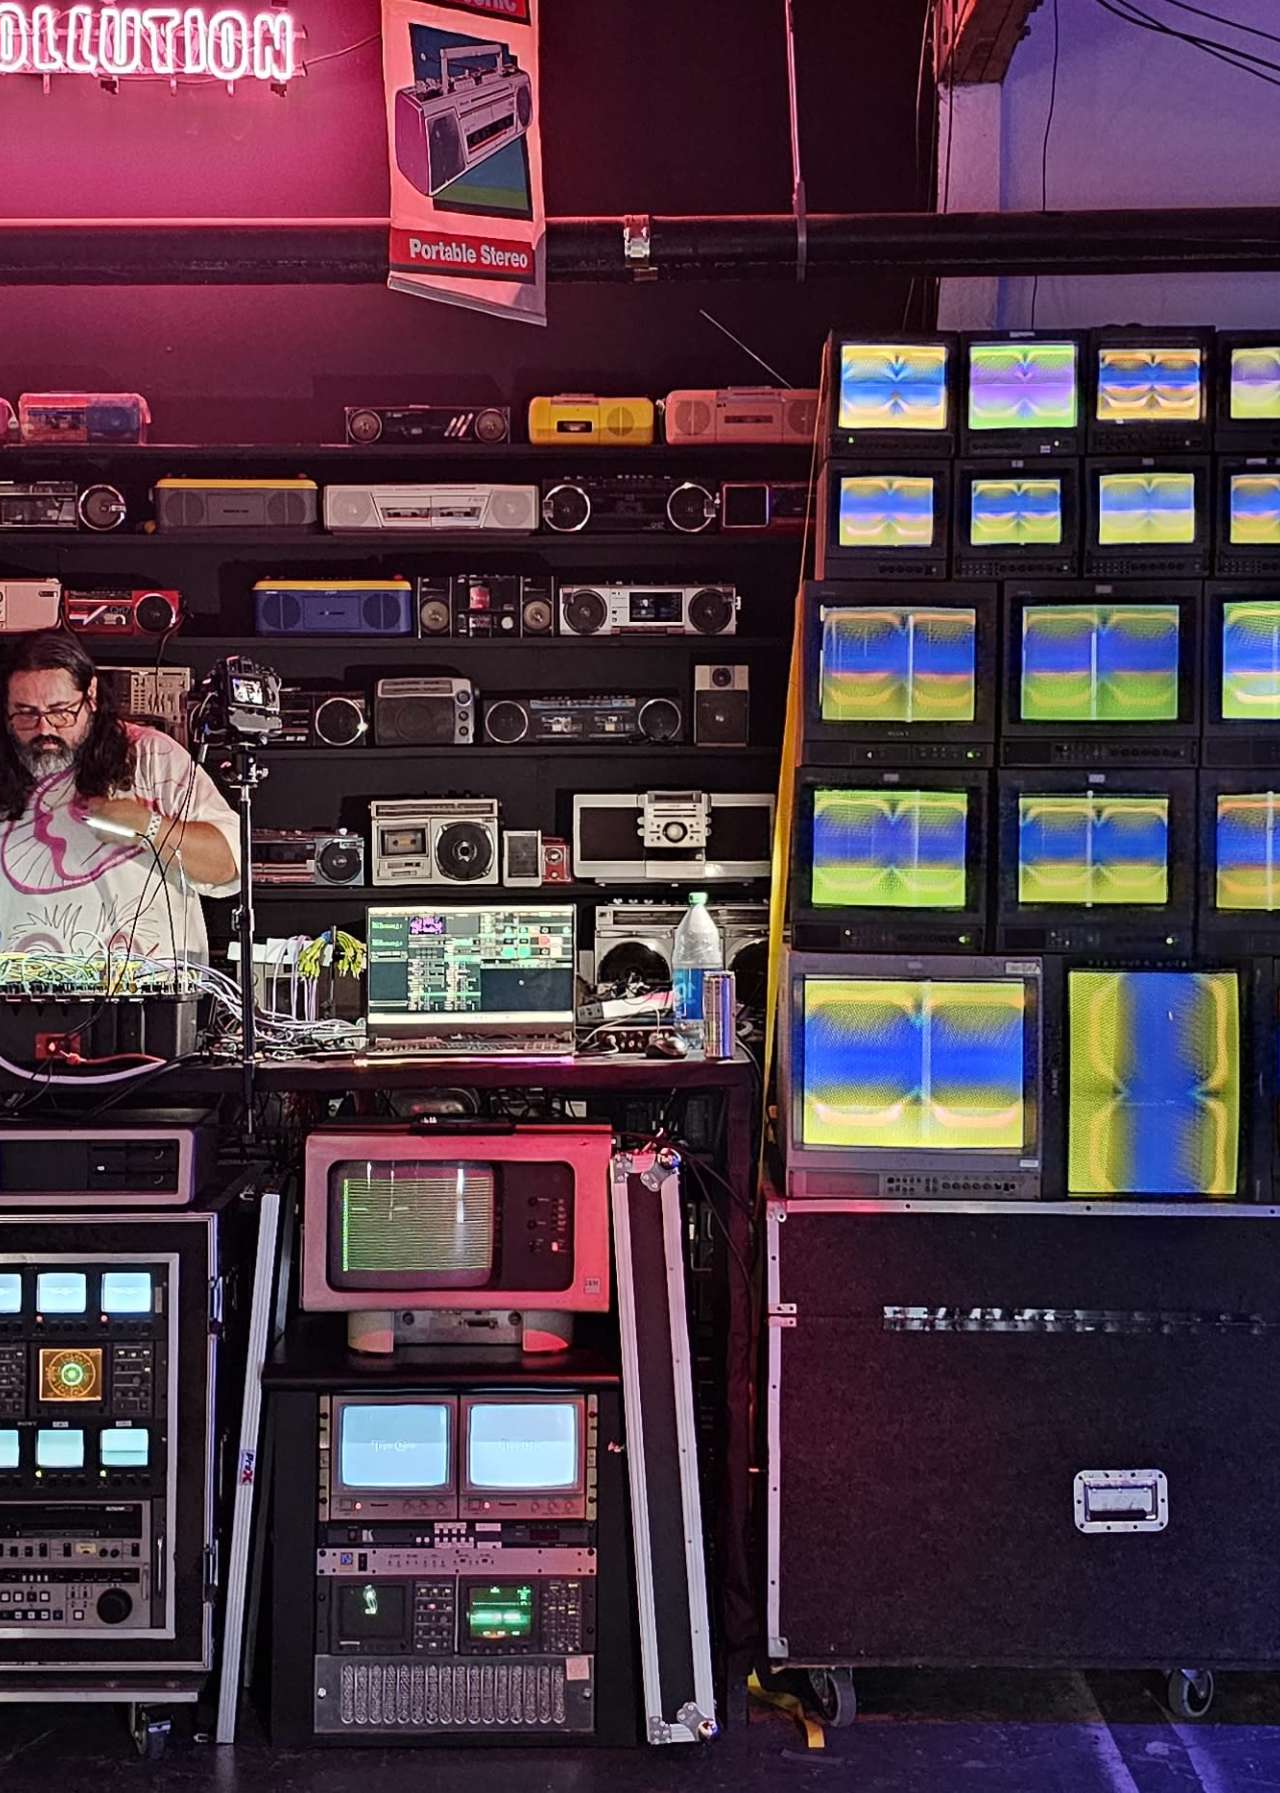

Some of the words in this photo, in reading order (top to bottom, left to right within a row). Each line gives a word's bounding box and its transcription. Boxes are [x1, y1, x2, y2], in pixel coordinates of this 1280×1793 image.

[409, 238, 477, 264] Portable
[480, 244, 529, 269] Stereo
[242, 1452, 255, 1484] ProX
